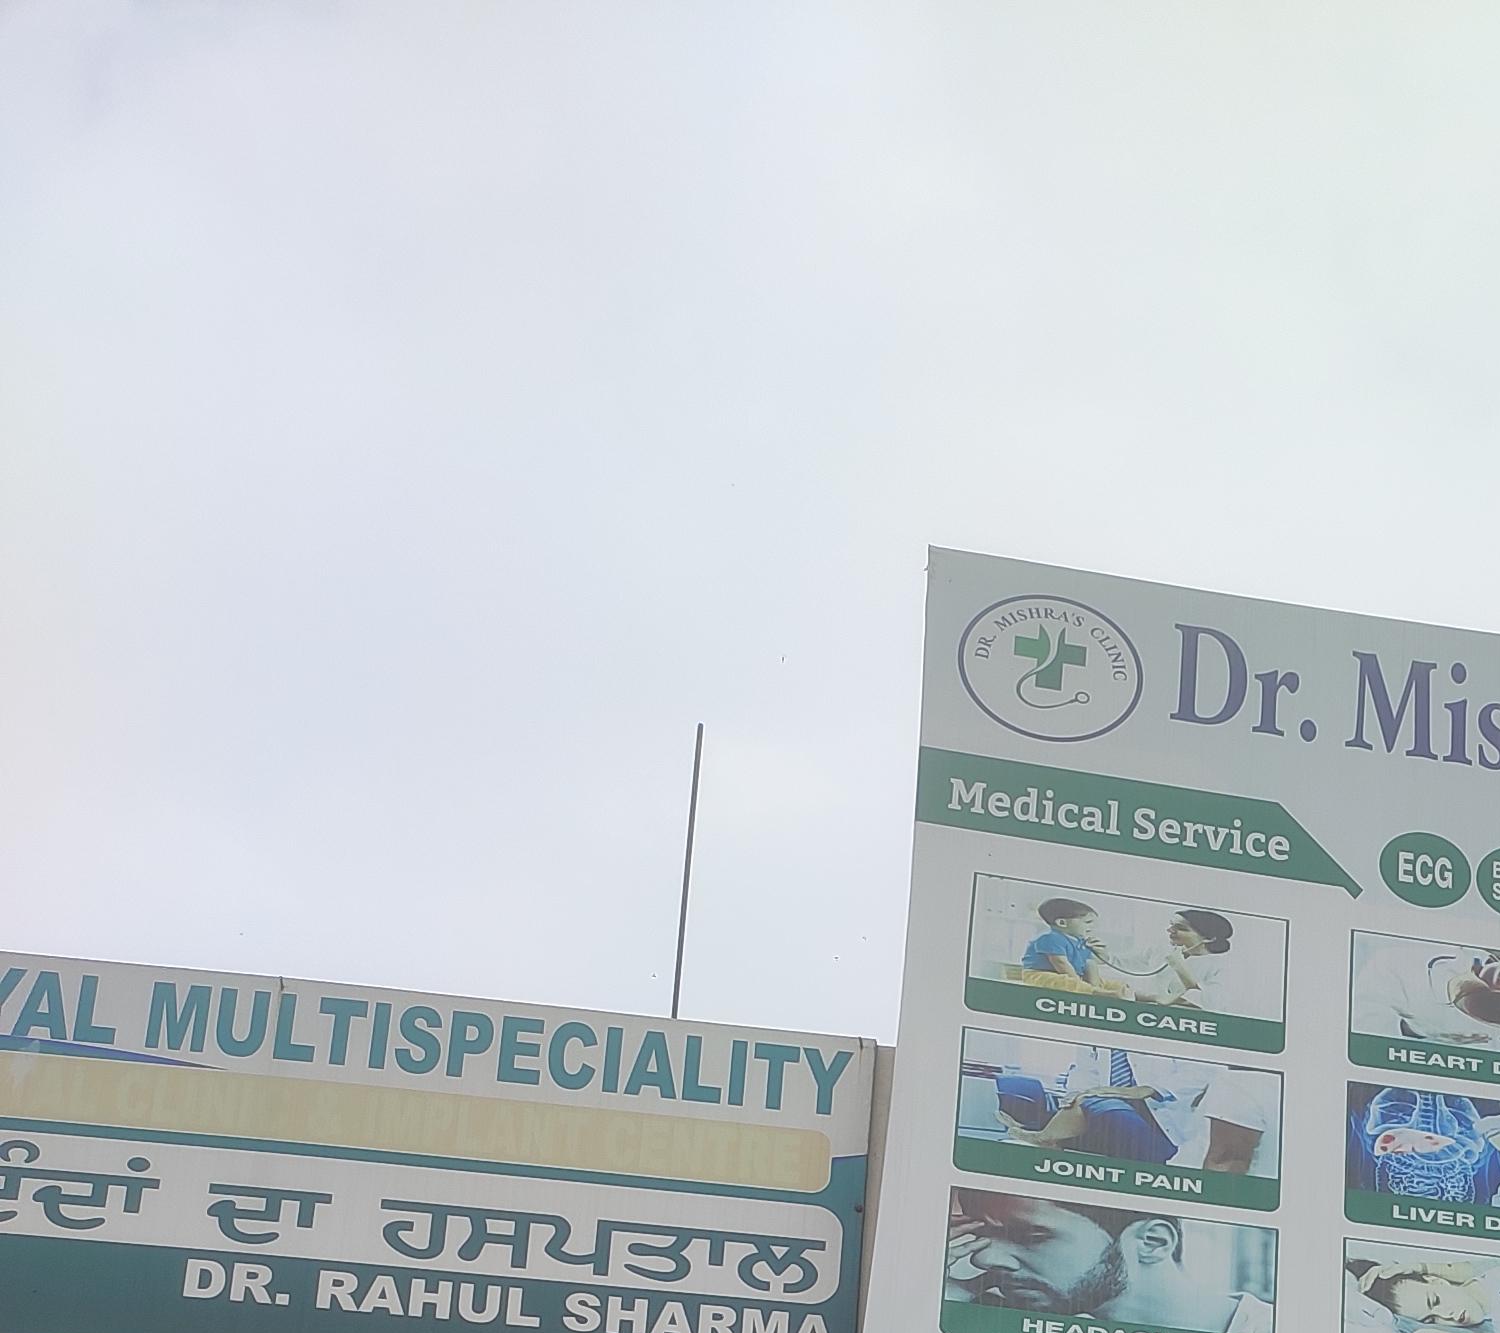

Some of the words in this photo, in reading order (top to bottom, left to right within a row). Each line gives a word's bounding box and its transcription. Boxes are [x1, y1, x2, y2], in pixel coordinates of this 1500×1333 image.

[993, 607, 1087, 634] MISHRA'S
[1089, 627, 1128, 682] CLINIC
[1169, 622, 1318, 743] Dr.
[948, 778, 1121, 837] Medical
[1133, 808, 1291, 862] Service
[1397, 851, 1454, 889] ECG
[146, 980, 854, 1116] MULTISPECIALITY
[1035, 997, 1127, 1024] CHILD
[1136, 1011, 1218, 1037] CARE
[1388, 1047, 1483, 1073] HEART
[1034, 1160, 1125, 1185] JOINT
[1134, 1171, 1203, 1194] PAIN
[206, 1182, 334, 1245] ਦਾ
[380, 1197, 827, 1294] ਹਸਪਤਾਲ
[1392, 1205, 1475, 1230] LIVER
[182, 1258, 290, 1306] DR.
[315, 1269, 540, 1329] RAHUL
